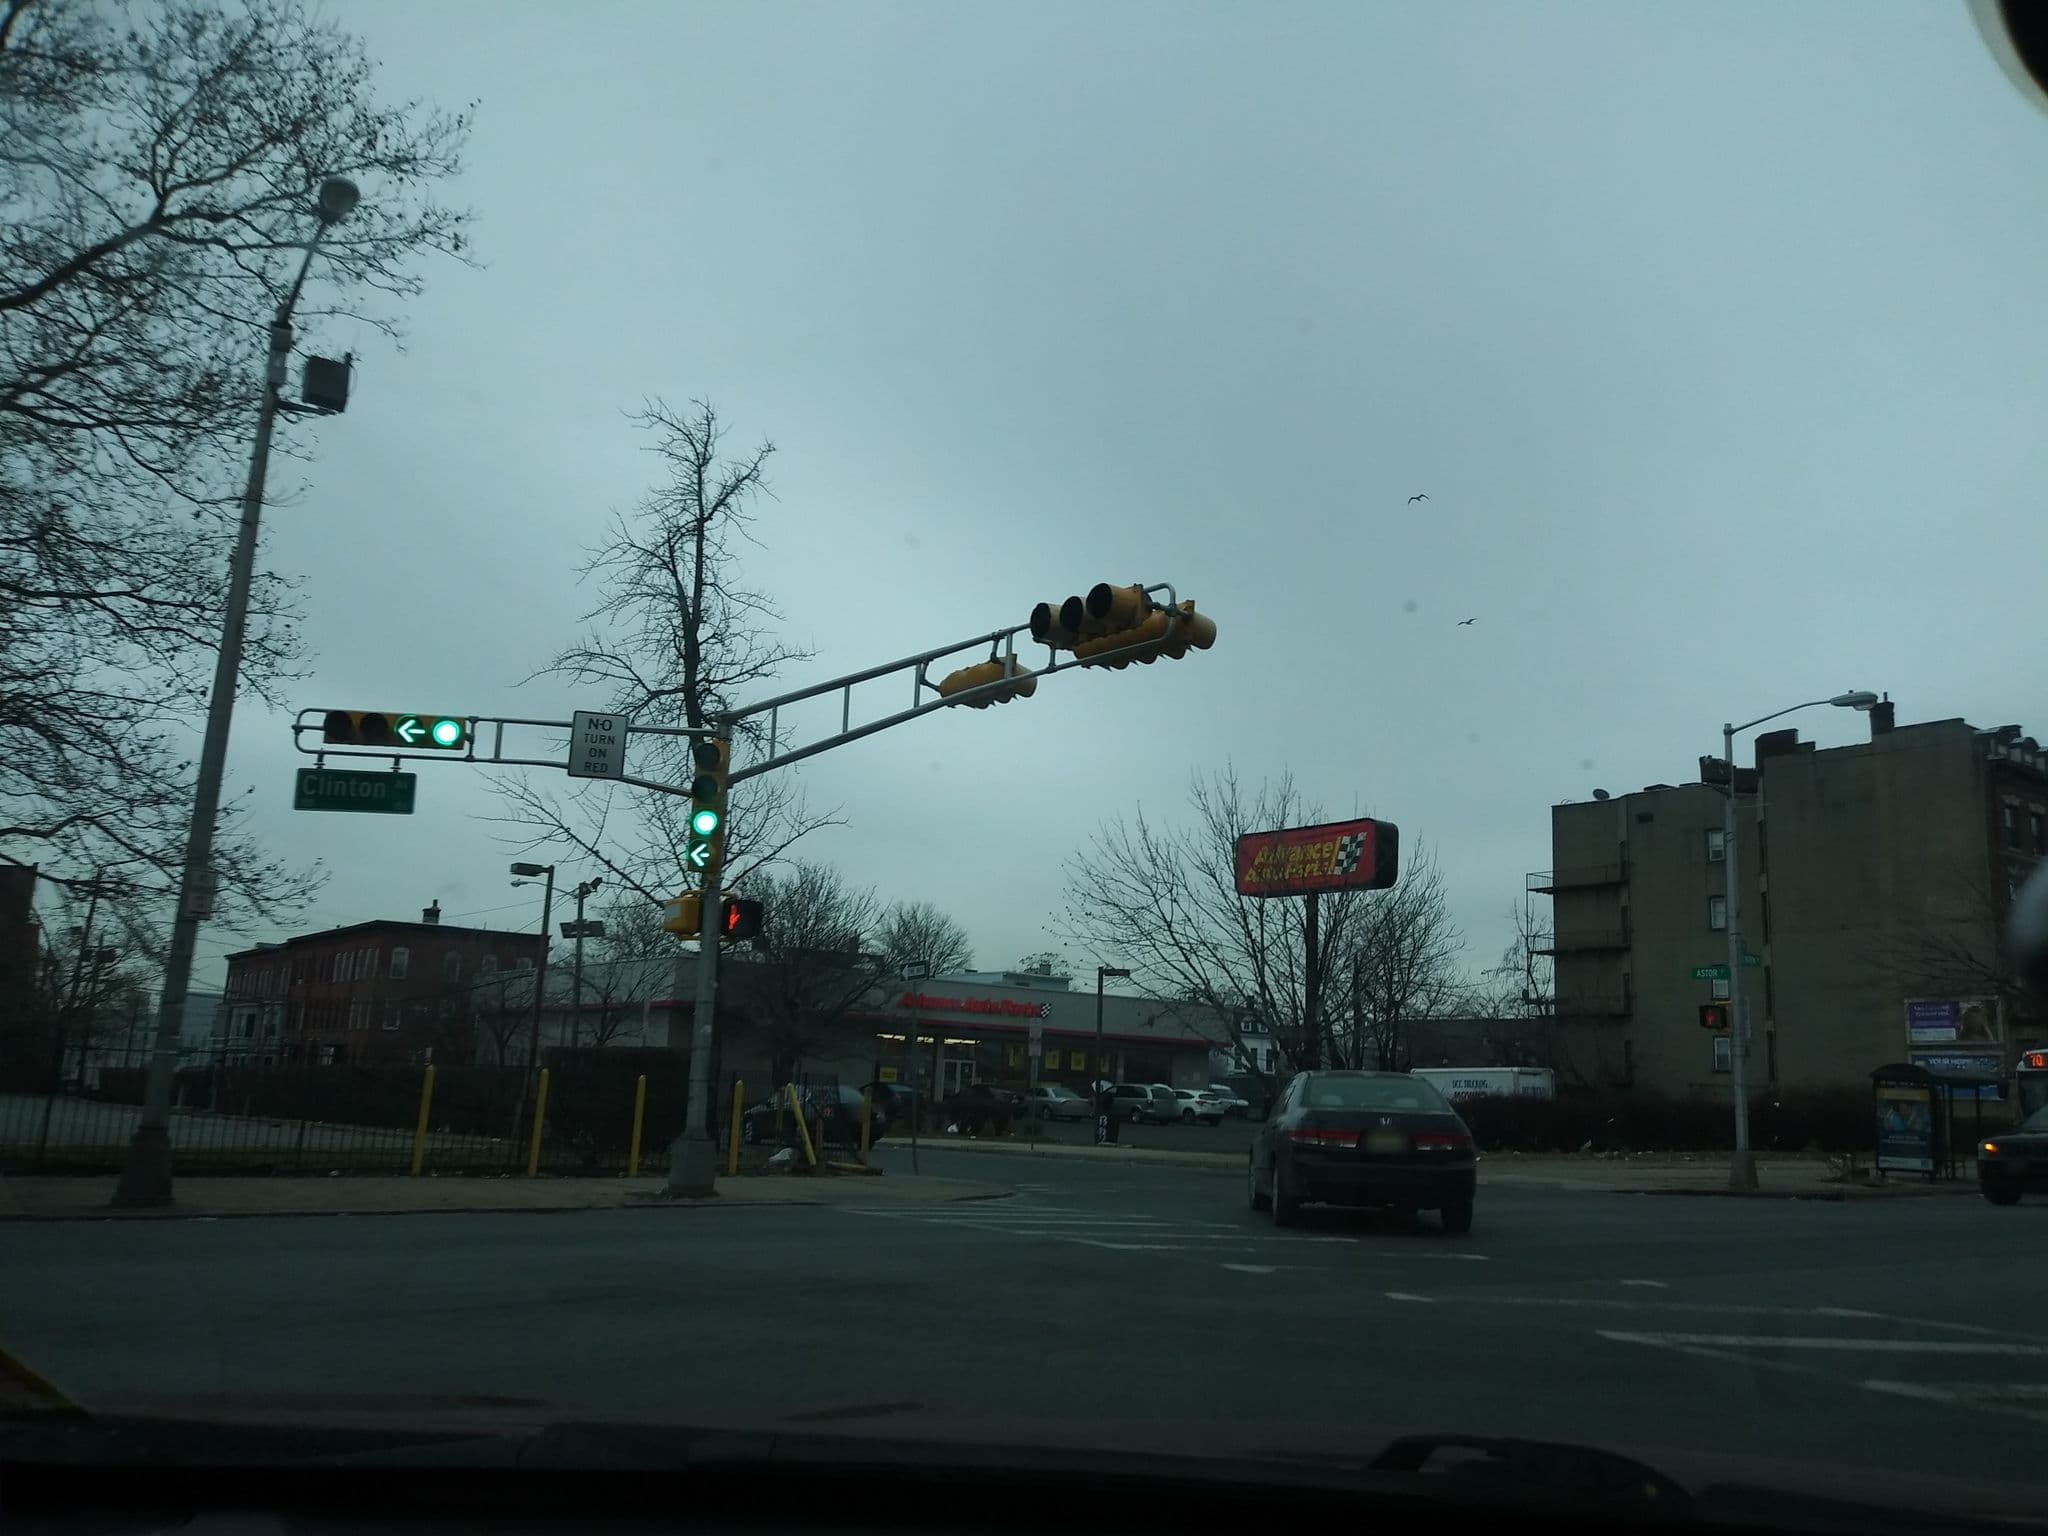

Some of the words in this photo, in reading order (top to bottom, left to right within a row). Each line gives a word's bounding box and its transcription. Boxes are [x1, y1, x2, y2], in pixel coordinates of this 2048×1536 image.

[588, 718, 613, 731] NO
[584, 733, 615, 745] TURN
[588, 747, 607, 758] ON
[583, 761, 608, 773] RED
[302, 774, 386, 798] Clinton
[1696, 968, 1718, 977] ASTOR
